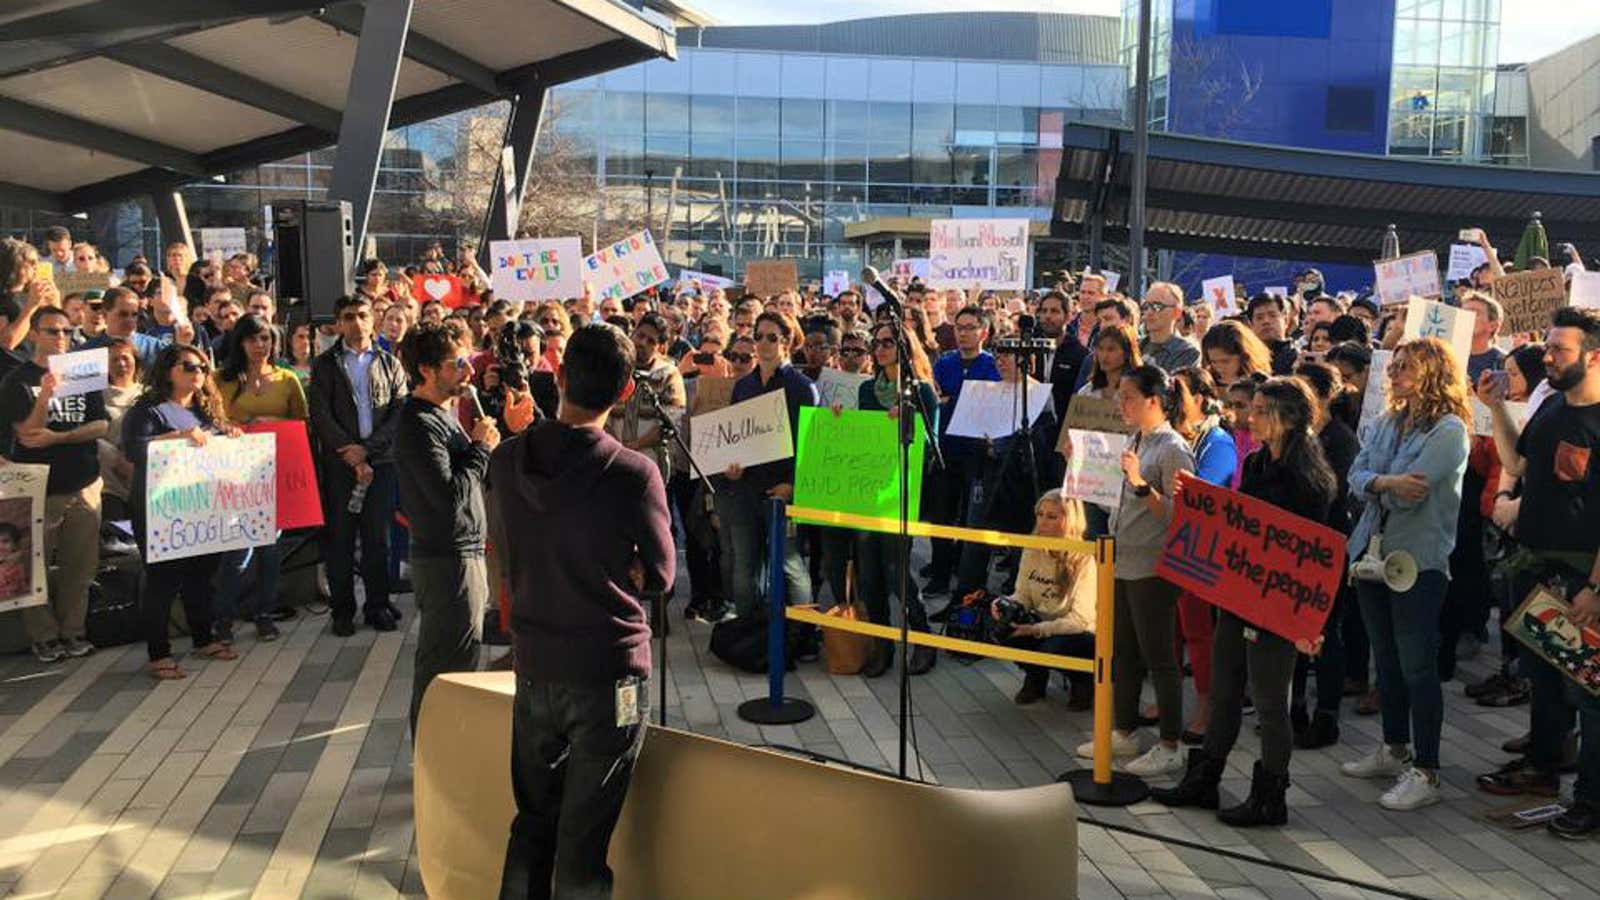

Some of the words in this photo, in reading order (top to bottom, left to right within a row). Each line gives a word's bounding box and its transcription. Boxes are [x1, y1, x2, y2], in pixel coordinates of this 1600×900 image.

[541, 248, 558, 265] BE
[170, 513, 261, 550] GOOGLER
[1222, 502, 1261, 537] the
[1263, 524, 1334, 570] people
[1167, 519, 1223, 571] ALL
[1225, 541, 1265, 583] the
[1261, 570, 1331, 615] people
